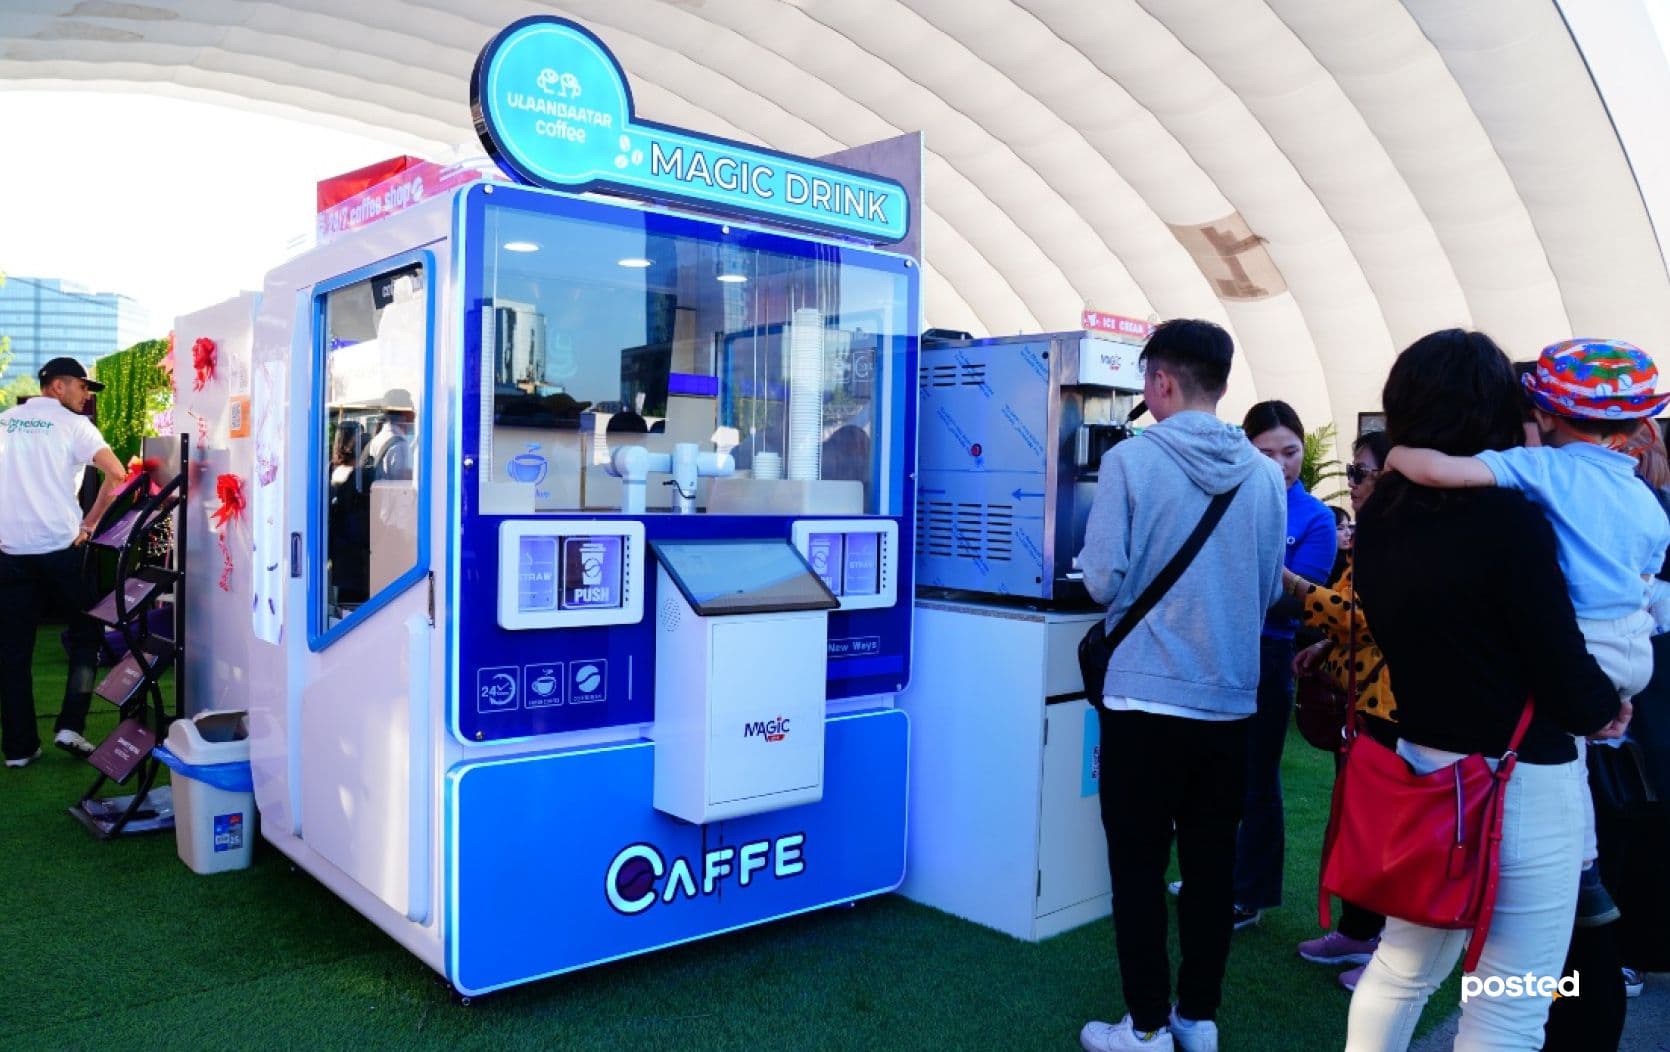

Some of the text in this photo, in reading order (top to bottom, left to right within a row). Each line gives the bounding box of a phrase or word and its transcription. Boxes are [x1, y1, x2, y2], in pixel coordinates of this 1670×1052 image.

[507, 92, 613, 128] ULAANBAATAR
[536, 119, 586, 143] coffee
[651, 141, 889, 224] MAGIC DRINK
[385, 184, 411, 209] shop
[519, 572, 553, 581] TRAW
[574, 587, 609, 602] PUSH
[828, 641, 878, 653] New Ways
[481, 685, 497, 697] 24
